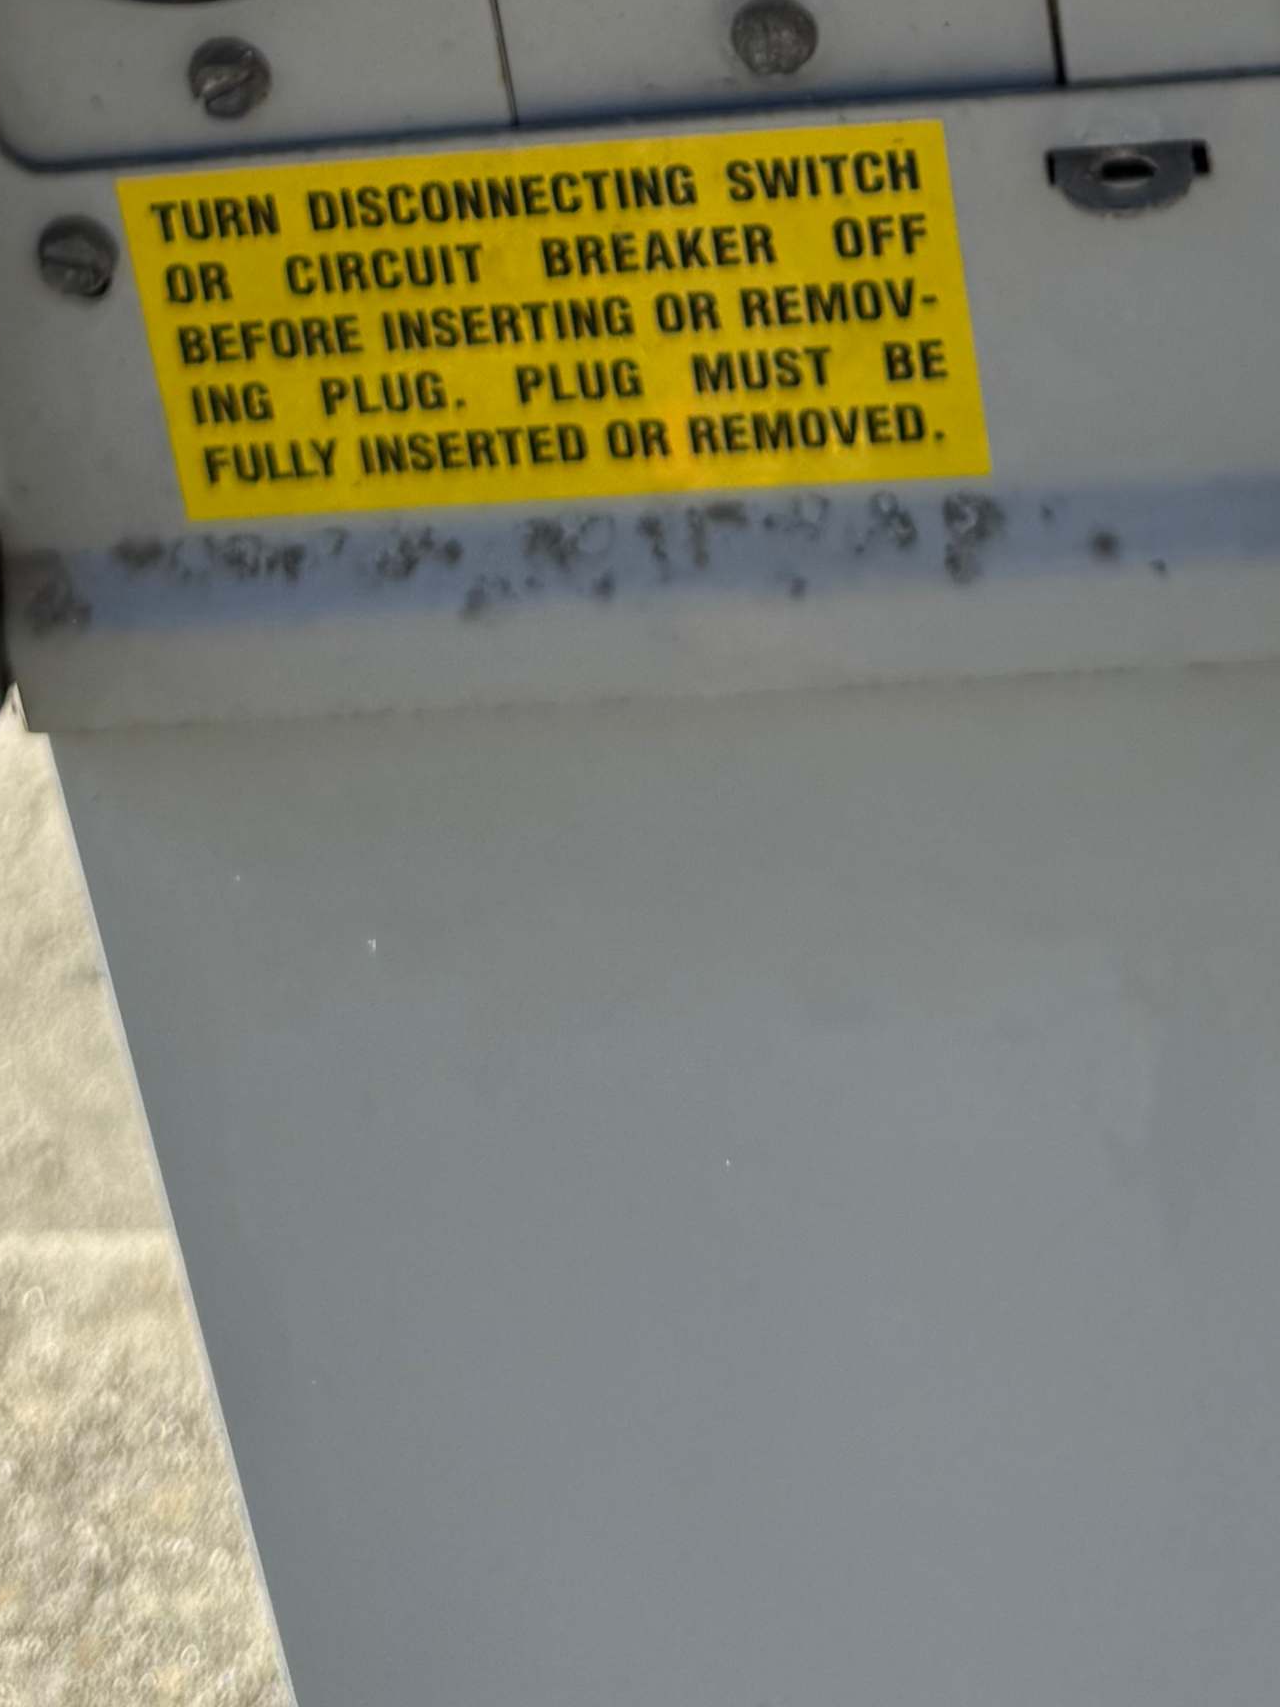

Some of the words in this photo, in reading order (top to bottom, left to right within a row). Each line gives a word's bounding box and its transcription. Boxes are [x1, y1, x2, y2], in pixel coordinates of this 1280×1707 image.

[150, 194, 280, 243] TURN
[306, 164, 697, 231] DISCONNECTING
[725, 149, 921, 202] SWITCH
[165, 262, 233, 305] OR
[285, 243, 483, 296] CIRCUIT
[541, 223, 777, 278] BREAKER
[832, 213, 928, 259] OFF
[177, 314, 363, 365] BEFORE
[382, 295, 635, 352] INSERTING
[655, 292, 721, 334] OR
[739, 278, 939, 328] REMOV-
[190, 382, 275, 426] ING
[320, 370, 467, 418] PLUG.
[514, 358, 644, 406] PLUG
[691, 346, 833, 396] MUST
[883, 340, 949, 383] BE
[203, 437, 339, 486] FULLY
[360, 422, 589, 477] INSERTED
[606, 419, 672, 460] OR
[687, 403, 946, 456] REMOVED.
